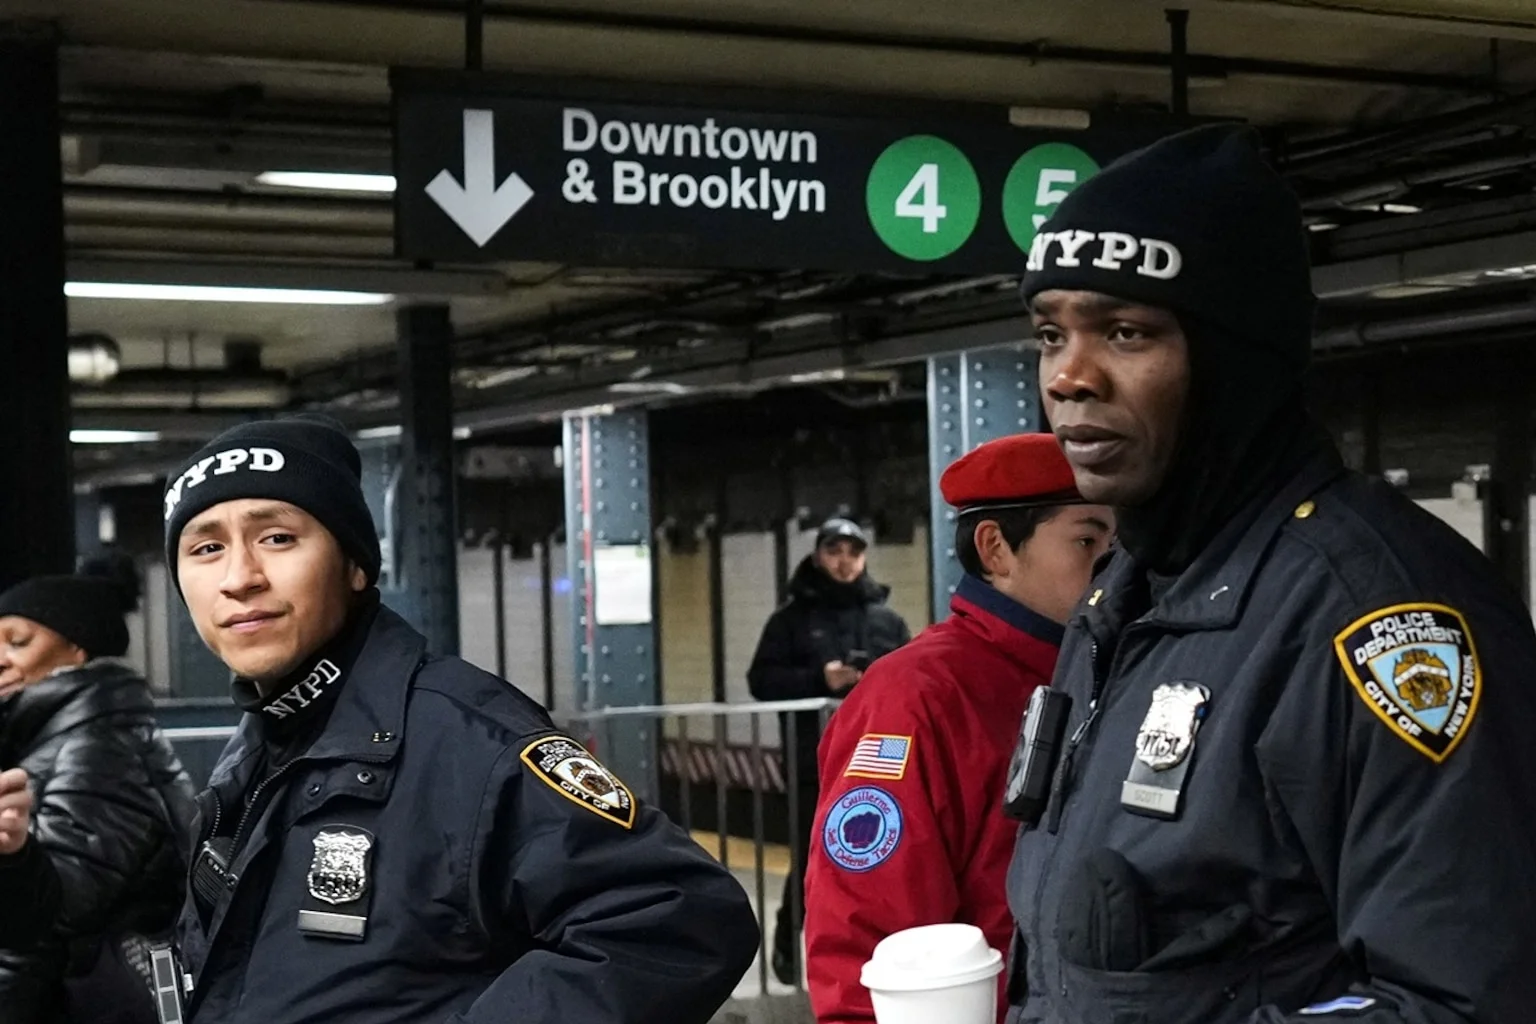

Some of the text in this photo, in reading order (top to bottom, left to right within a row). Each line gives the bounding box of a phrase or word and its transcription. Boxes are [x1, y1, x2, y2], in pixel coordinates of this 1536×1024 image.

[562, 107, 817, 163] Downtown
[561, 158, 826, 220] & Brooklyn
[895, 163, 1077, 233] 4 5
[1025, 229, 1182, 280] NYPD
[164, 447, 286, 520] NYPD
[1353, 626, 1463, 666] DEPARTMENT
[1370, 612, 1436, 638] POLICE
[263, 658, 342, 720] NYPD
[1364, 654, 1475, 738] CITY OF NEW YORK
[560, 781, 590, 800] CITY
